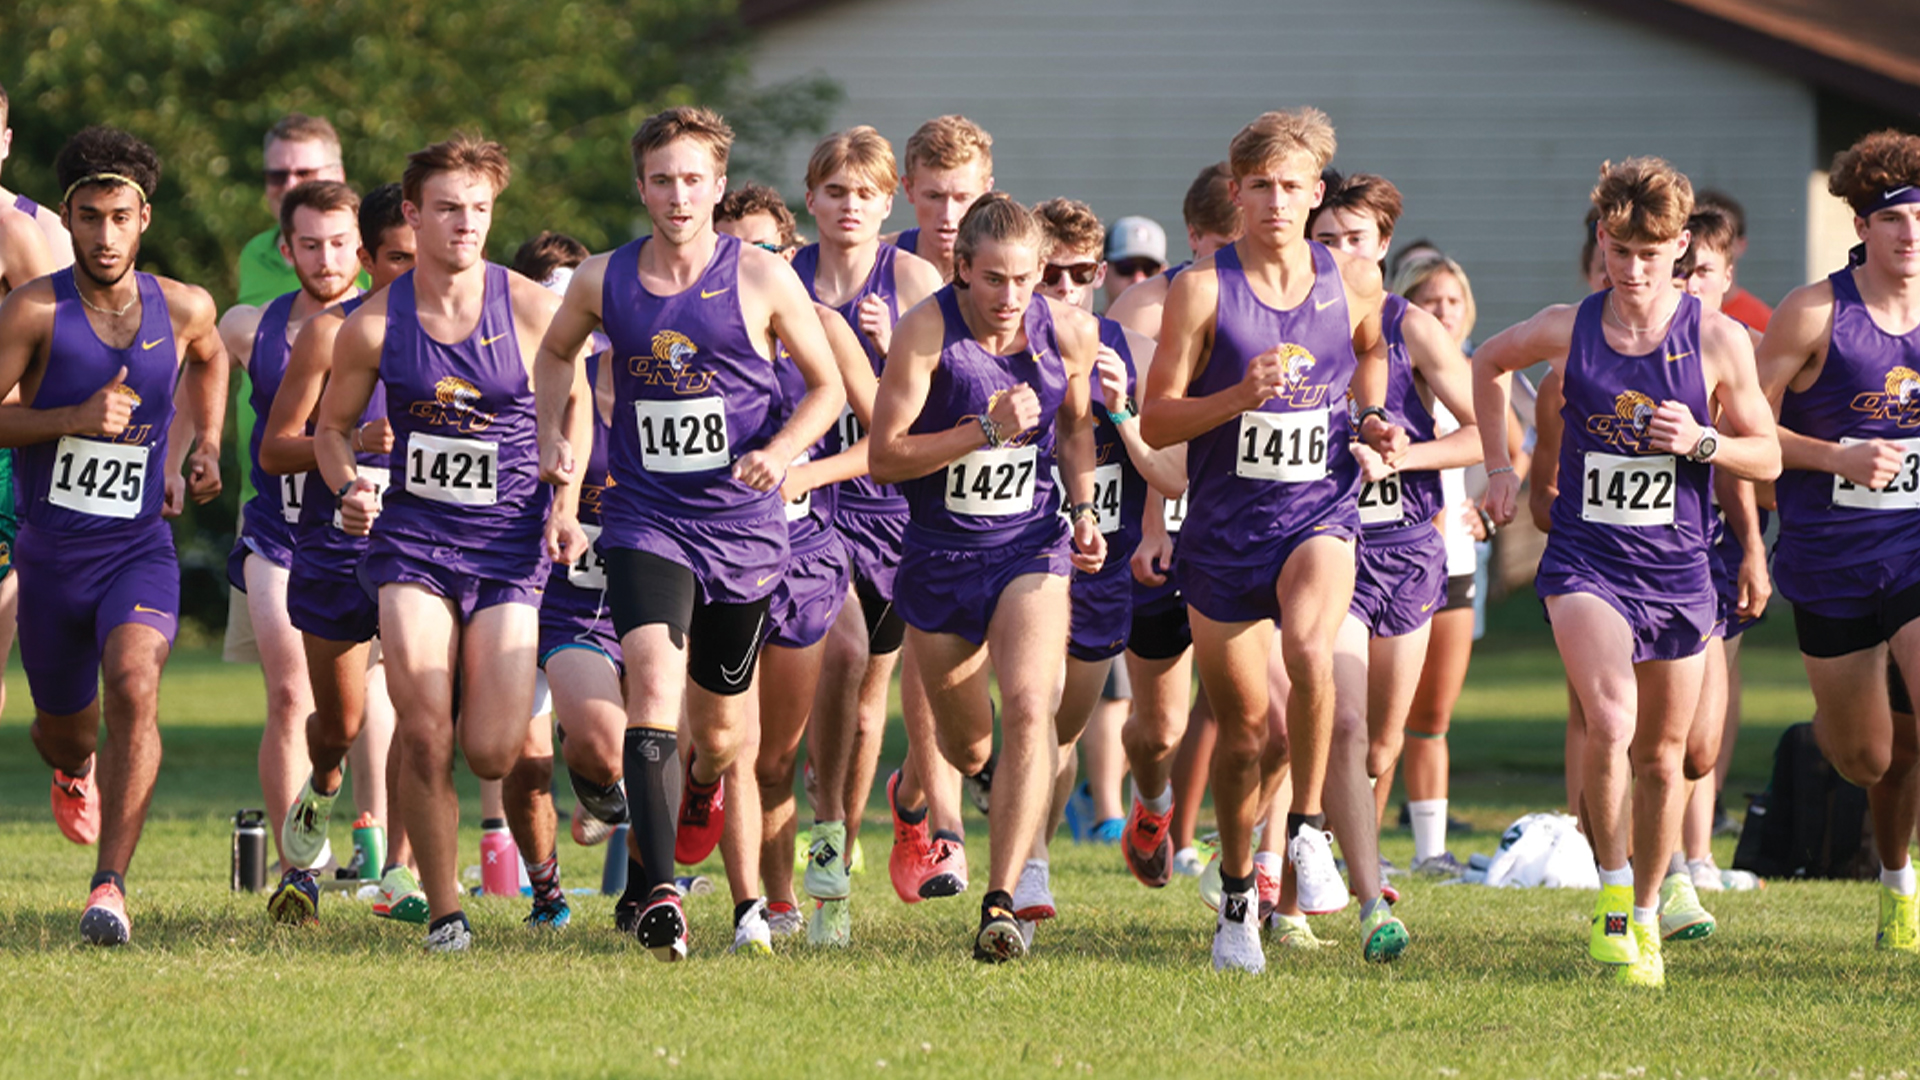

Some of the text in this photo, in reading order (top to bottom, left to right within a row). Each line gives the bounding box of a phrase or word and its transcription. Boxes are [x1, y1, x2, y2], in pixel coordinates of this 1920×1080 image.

[642, 413, 725, 456] 1428
[1242, 425, 1325, 465] 1416
[56, 452, 143, 502] 1425
[411, 448, 493, 489] 1421
[950, 460, 1033, 500] 1427
[1587, 467, 1673, 510] 1422
